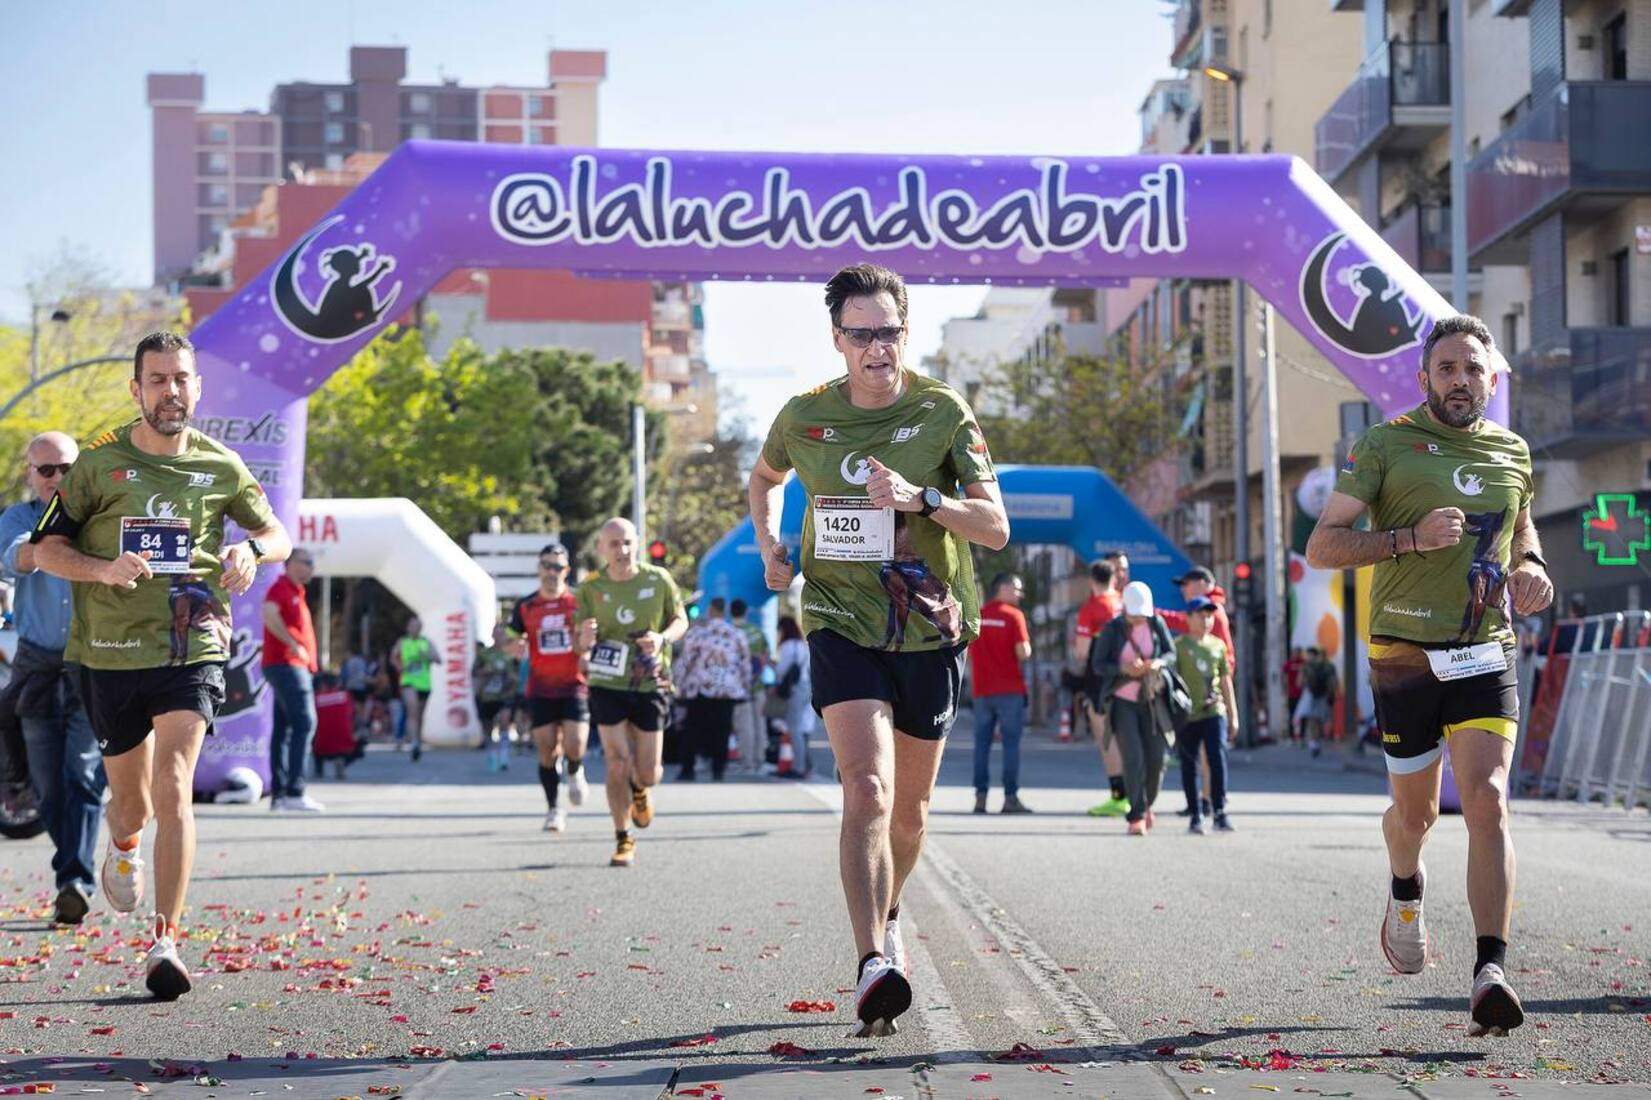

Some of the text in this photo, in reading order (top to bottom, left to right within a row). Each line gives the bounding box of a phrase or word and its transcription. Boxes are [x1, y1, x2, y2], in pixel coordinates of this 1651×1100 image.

[490, 154, 1187, 254] @laluchadeabril
[823, 516, 861, 532] 1420
[140, 533, 162, 549] 84
[822, 534, 866, 544] SALVADOR
[446, 611, 467, 702] YAMAHA
[1450, 651, 1475, 664] ABEL
